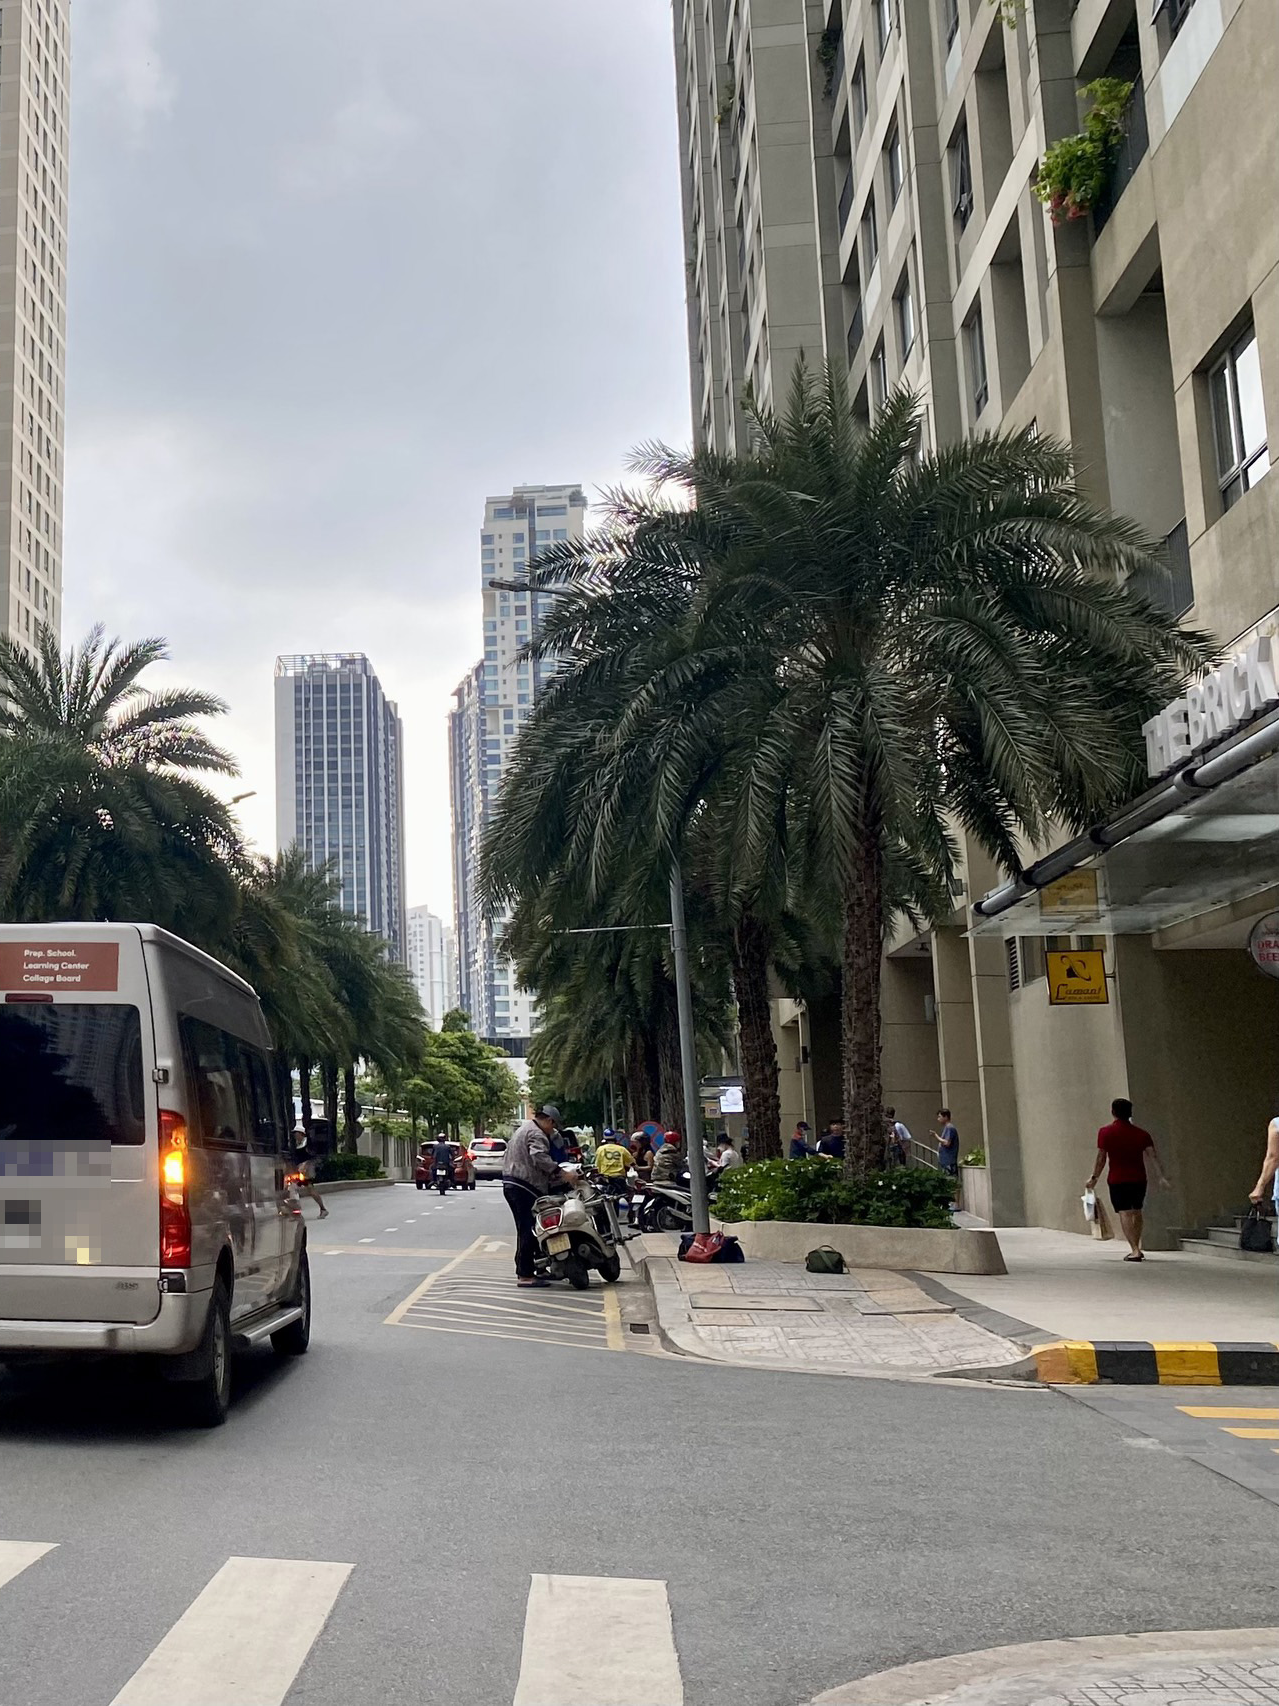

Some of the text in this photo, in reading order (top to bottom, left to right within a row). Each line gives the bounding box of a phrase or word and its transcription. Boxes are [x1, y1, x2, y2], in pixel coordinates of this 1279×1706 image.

[1142, 635, 1279, 778] THE BRICK
[23, 962, 60, 971] Learning
[604, 1148, 621, 1160] be
